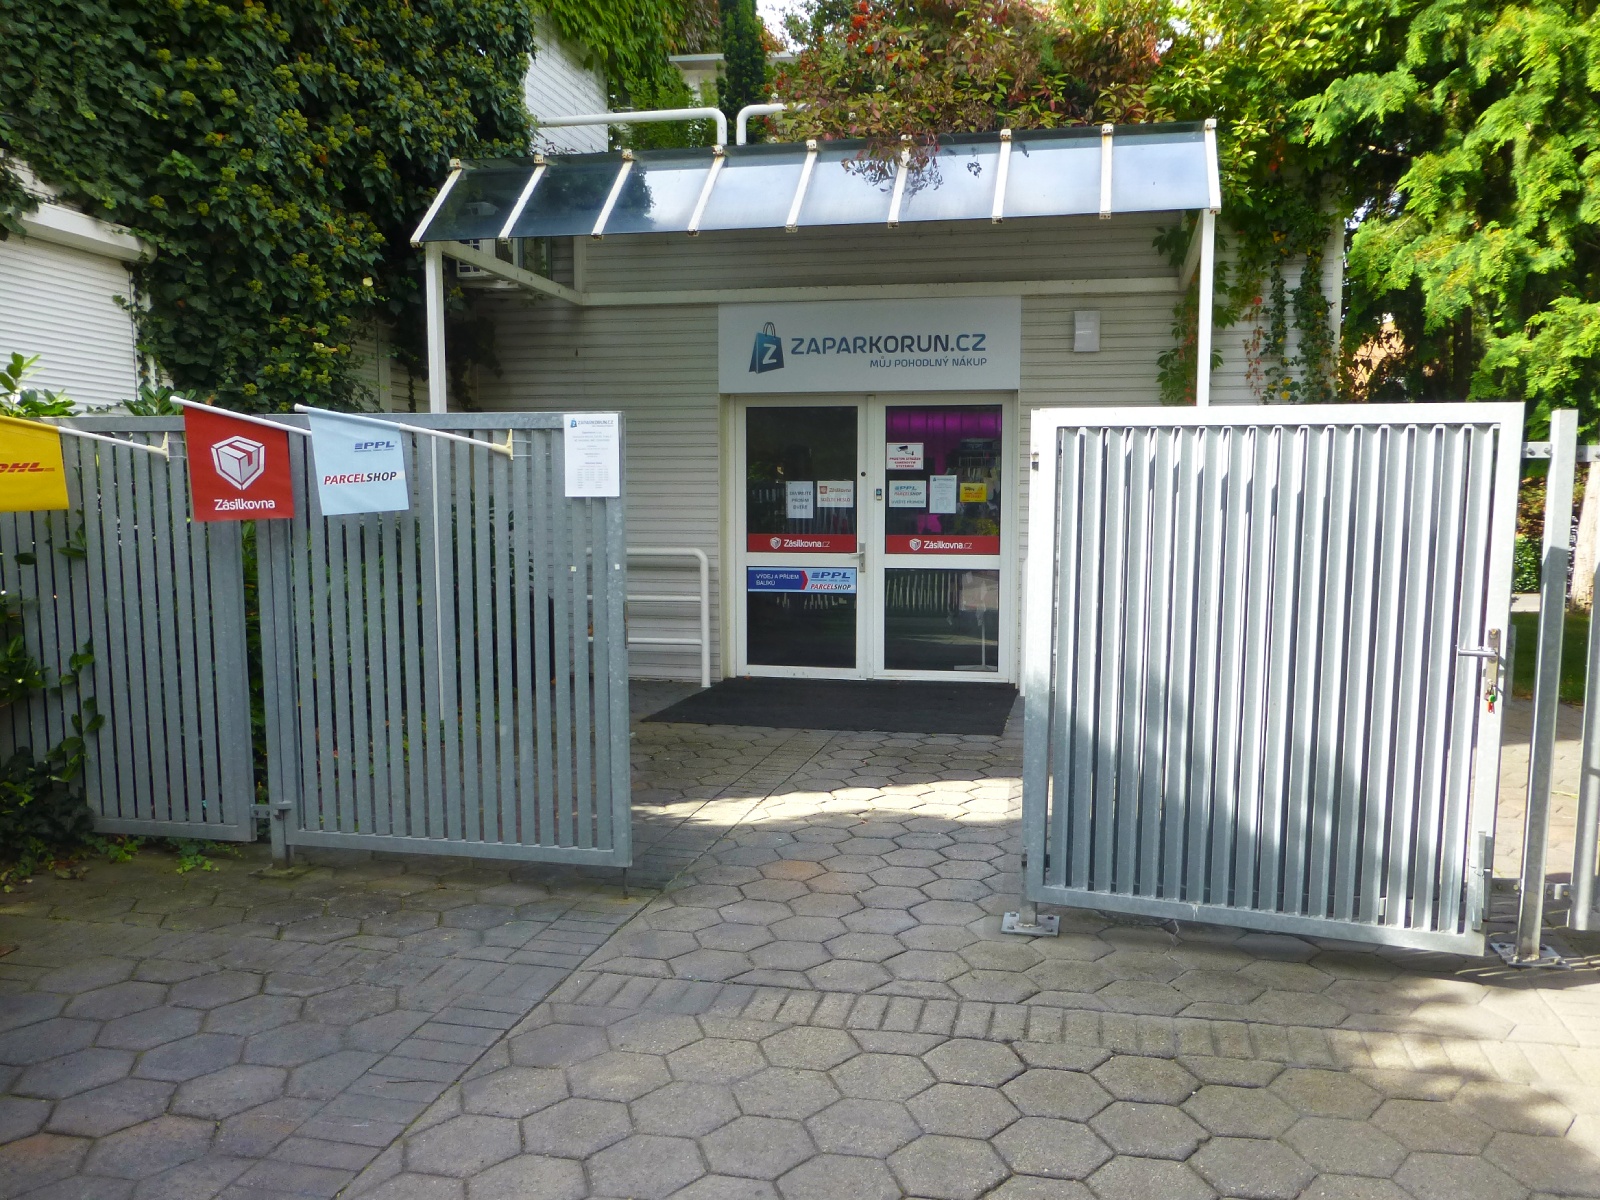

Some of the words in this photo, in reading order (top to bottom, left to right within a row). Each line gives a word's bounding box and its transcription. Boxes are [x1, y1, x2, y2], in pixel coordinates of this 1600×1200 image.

[791, 333, 986, 355] ZAPARKORUN.CZ
[870, 355, 891, 368] MŮJ
[894, 356, 949, 367] POHODLNÝ
[952, 355, 987, 367] NÁKUP
[363, 441, 395, 449] PPL
[324, 471, 397, 485] PARCELSHOP
[214, 497, 276, 511] Zásilkovna
[783, 538, 830, 548] Zásilkovna.cz
[923, 540, 972, 550] Zásilkovna.cz
[820, 571, 851, 579] PPL
